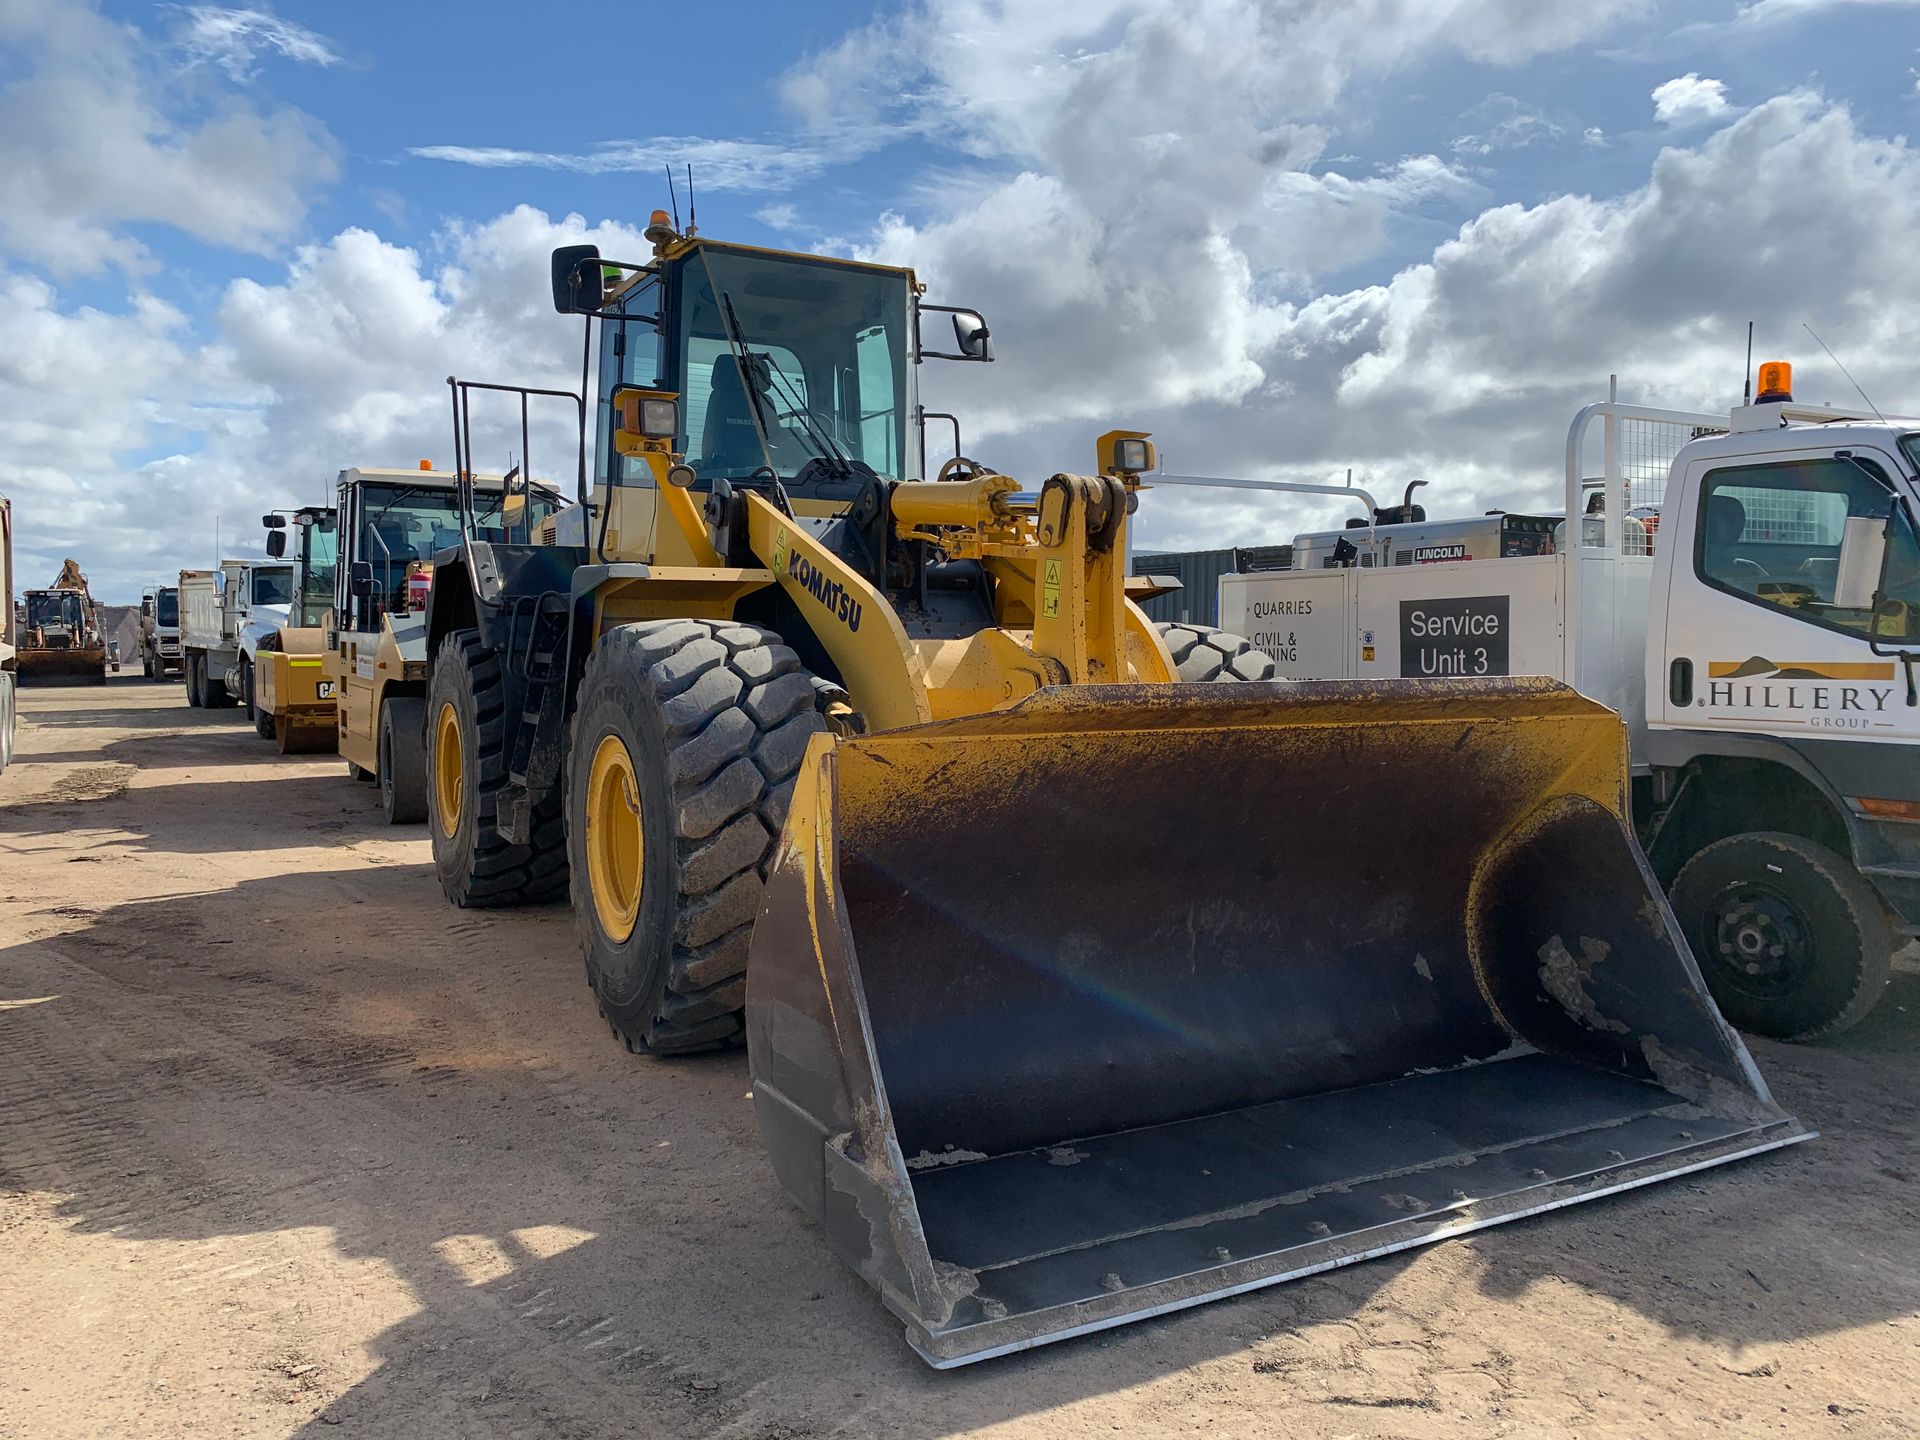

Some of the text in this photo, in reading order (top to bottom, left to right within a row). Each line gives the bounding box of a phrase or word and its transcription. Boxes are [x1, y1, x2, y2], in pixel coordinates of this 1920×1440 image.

[1416, 547, 1463, 560] LINCOLN
[789, 548, 862, 633] KOMATSU
[1254, 601, 1312, 618] QUARRIES
[1410, 609, 1499, 637] Service
[1254, 632, 1297, 646] CIVIL &
[1420, 648, 1488, 675] Unit 3
[1709, 682, 1895, 711] HILLERY
[1811, 717, 1869, 728] GROUP
